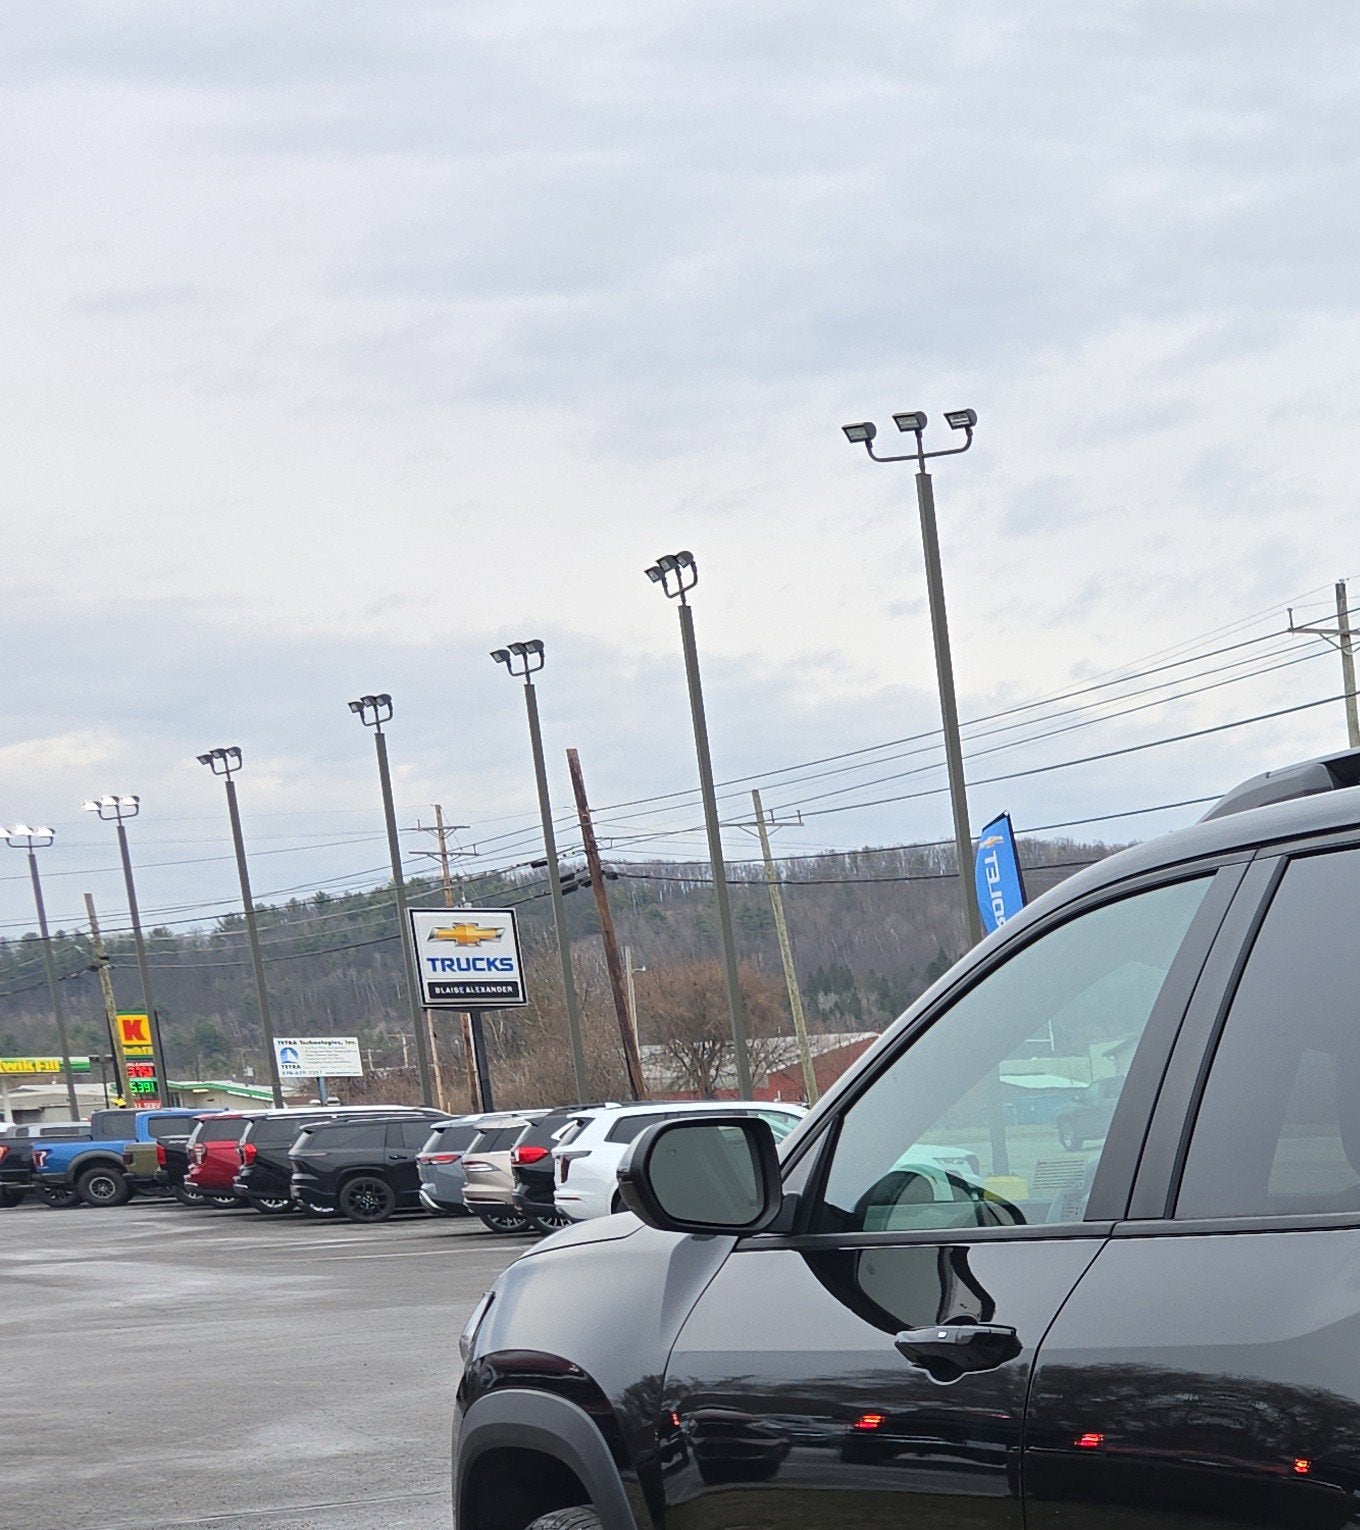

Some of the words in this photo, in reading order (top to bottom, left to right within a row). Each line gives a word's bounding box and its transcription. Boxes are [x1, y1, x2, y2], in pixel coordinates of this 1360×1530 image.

[426, 957, 514, 973] TRUCKS
[434, 986, 465, 995] BLAISE
[465, 985, 514, 994] ALEXANDER
[122, 1019, 147, 1041] K
